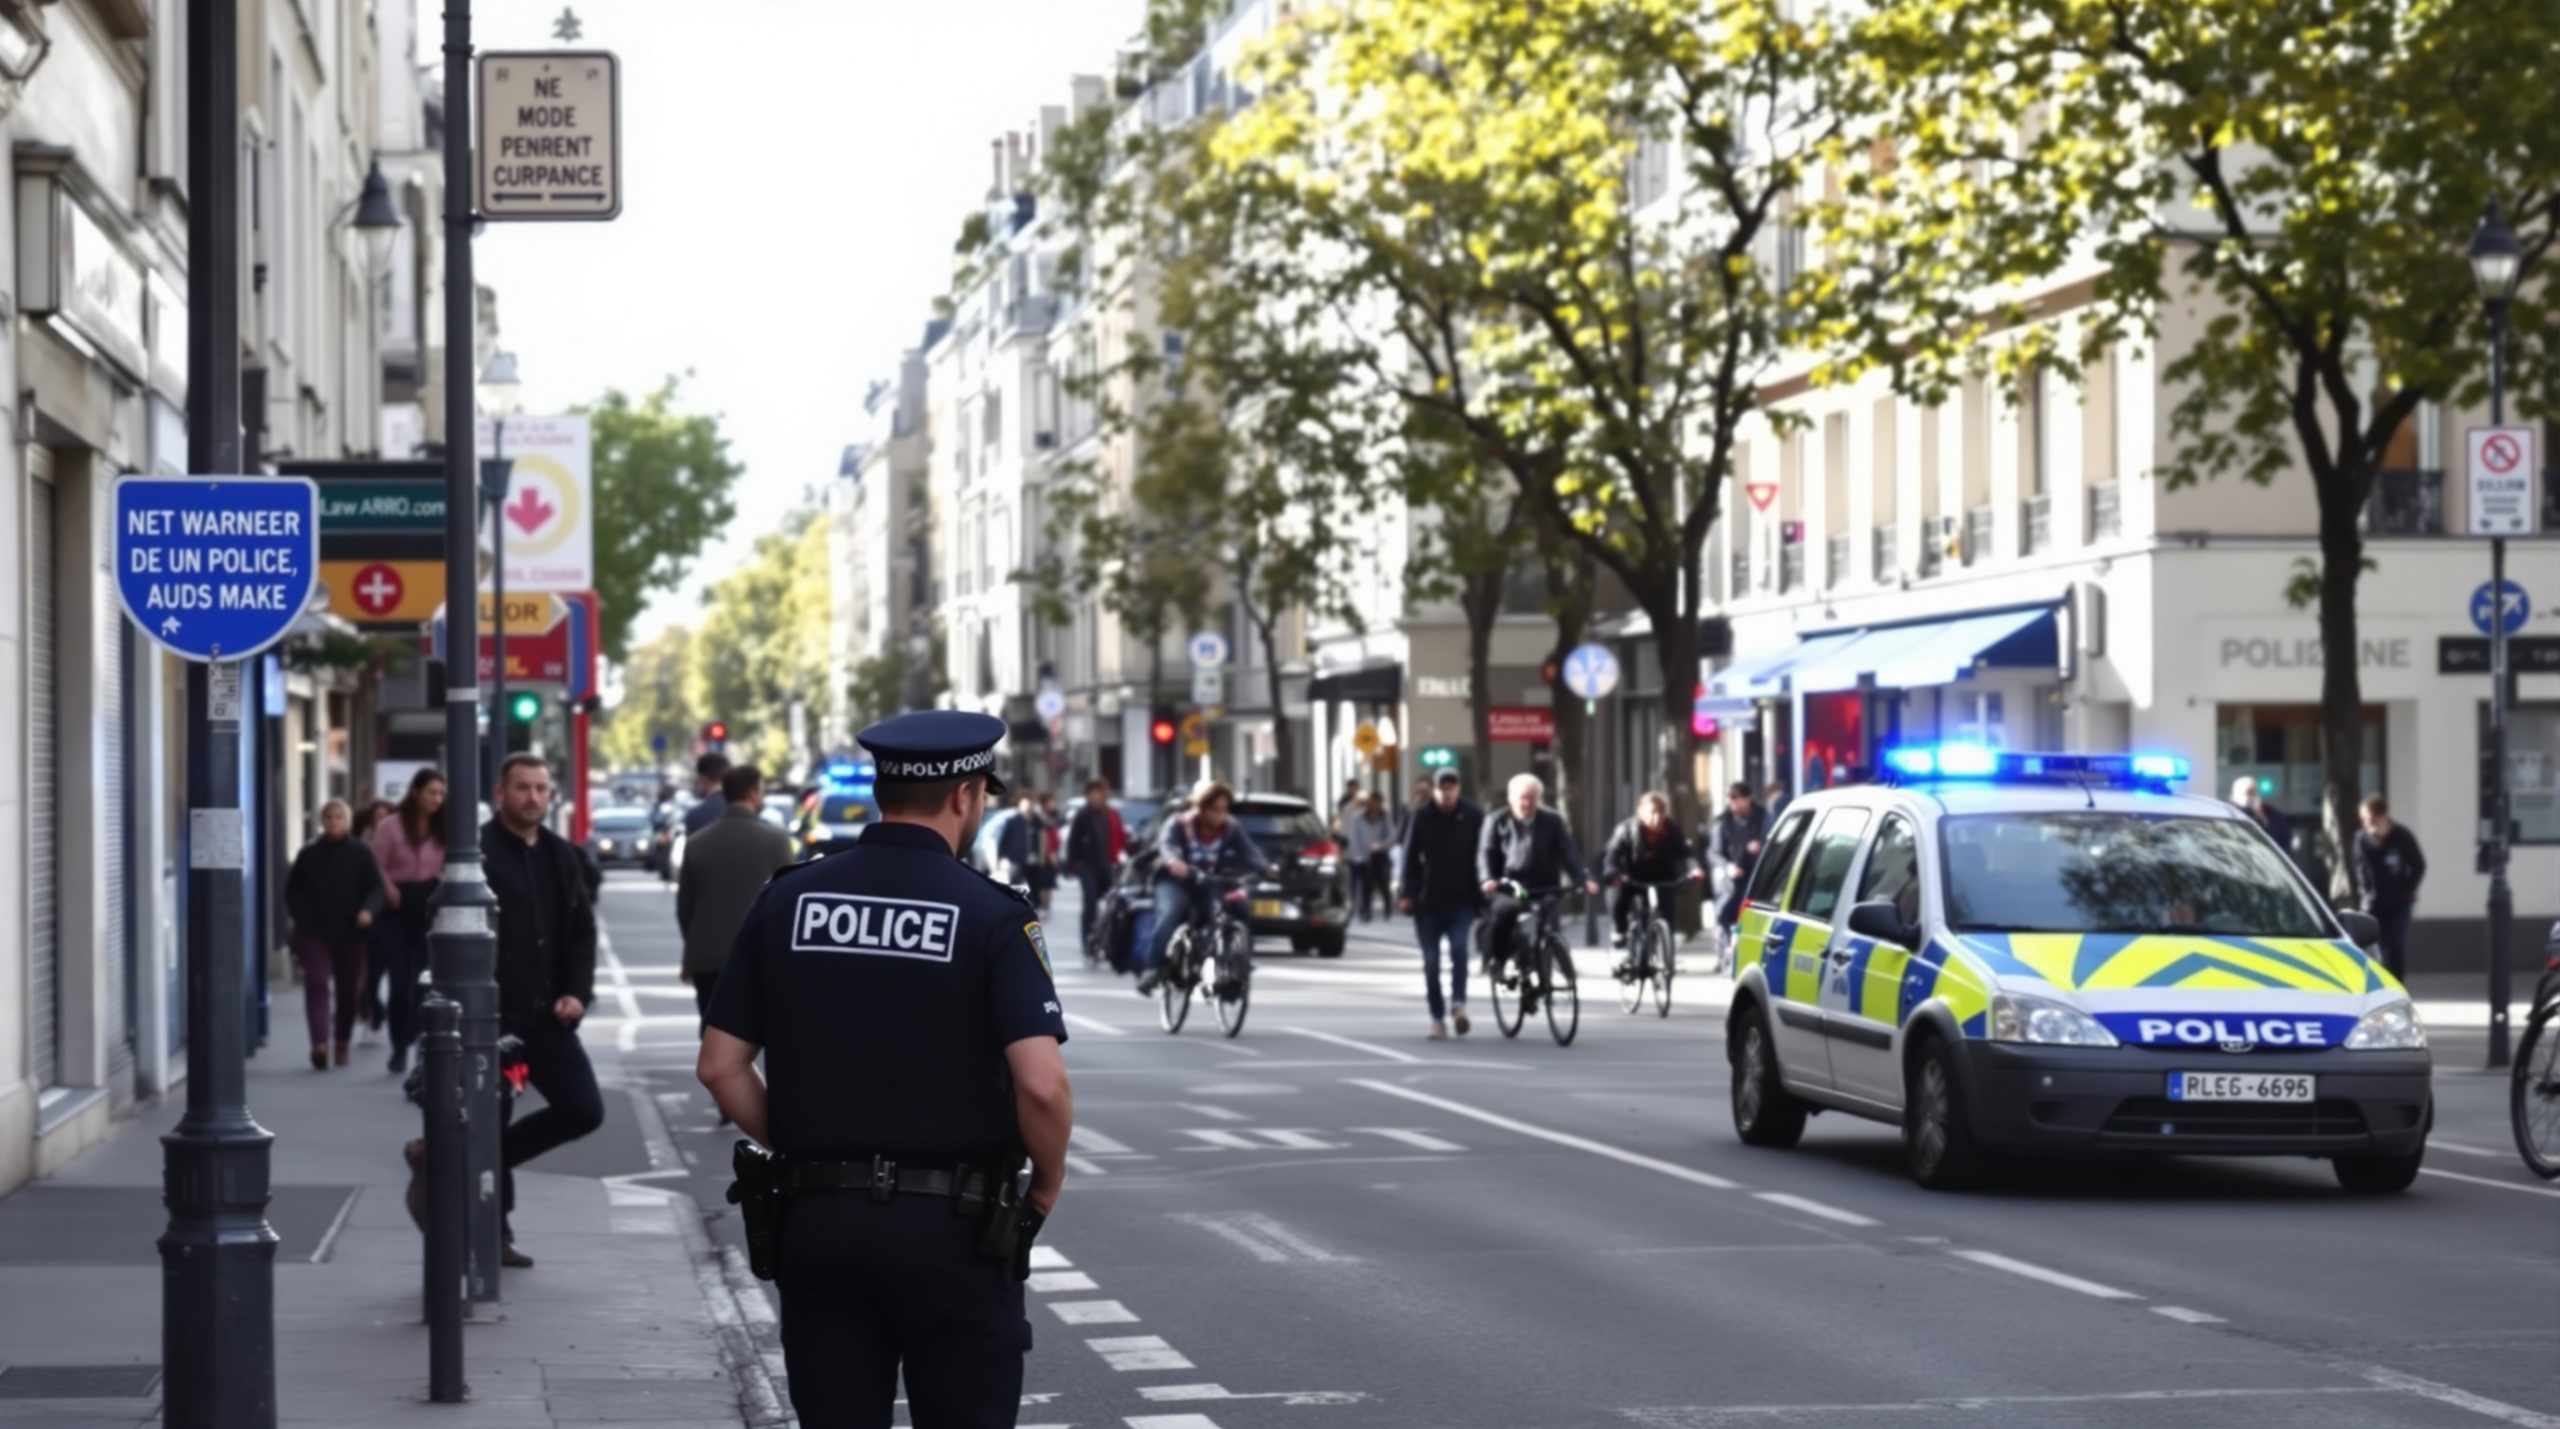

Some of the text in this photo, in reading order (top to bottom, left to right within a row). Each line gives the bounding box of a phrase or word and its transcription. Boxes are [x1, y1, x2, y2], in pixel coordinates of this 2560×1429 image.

[534, 77, 562, 98] NE
[517, 106, 577, 127] MODE
[501, 136, 592, 157] PENRENT
[493, 165, 603, 186] CURPANCE
[128, 510, 300, 536] NET WARNEER
[130, 548, 298, 577] DE UN POLICE,
[146, 583, 287, 609] AUDS MAKE
[902, 762, 948, 776] POLY
[803, 902, 950, 952] POLICE
[2138, 1018, 2327, 1045] POLICE
